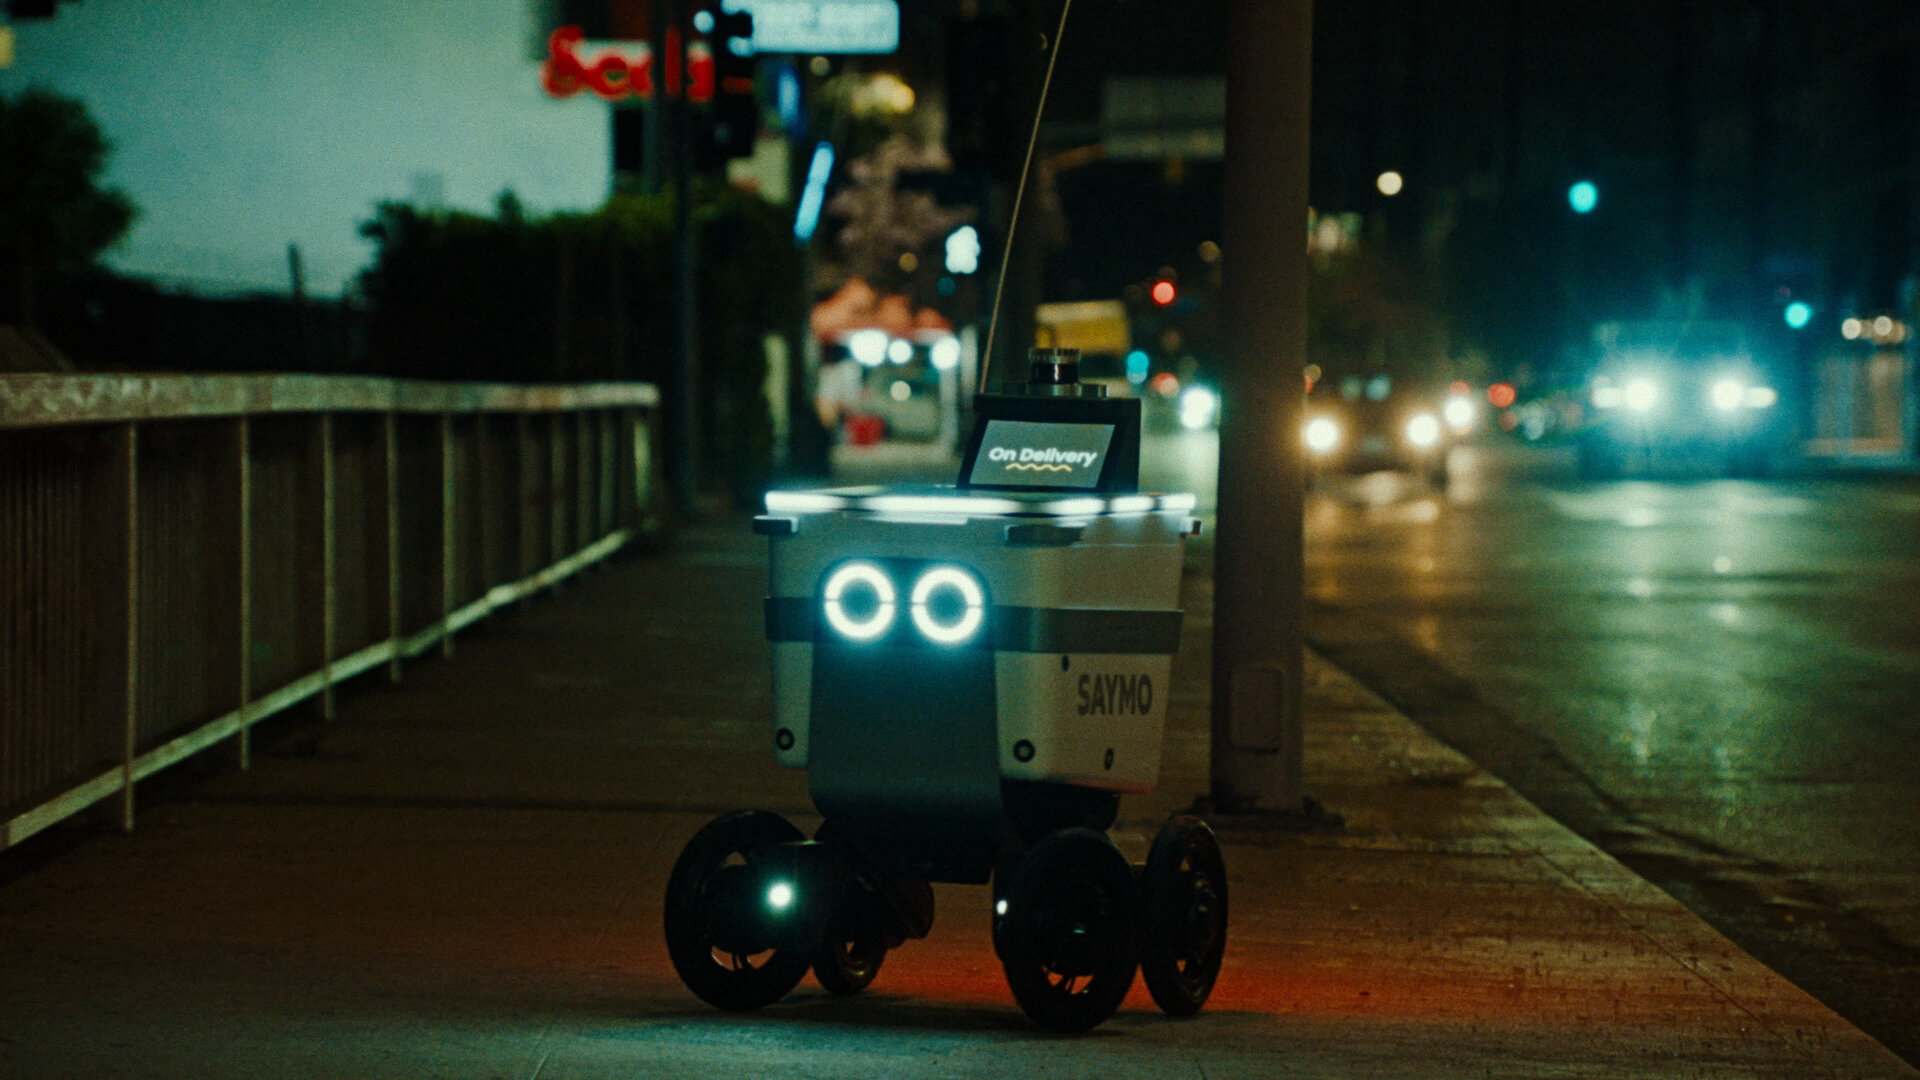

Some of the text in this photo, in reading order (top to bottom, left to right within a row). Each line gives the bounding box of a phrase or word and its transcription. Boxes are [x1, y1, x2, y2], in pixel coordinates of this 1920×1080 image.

[988, 447, 1098, 468] On Delivery
[1077, 673, 1153, 715] SAYMO
